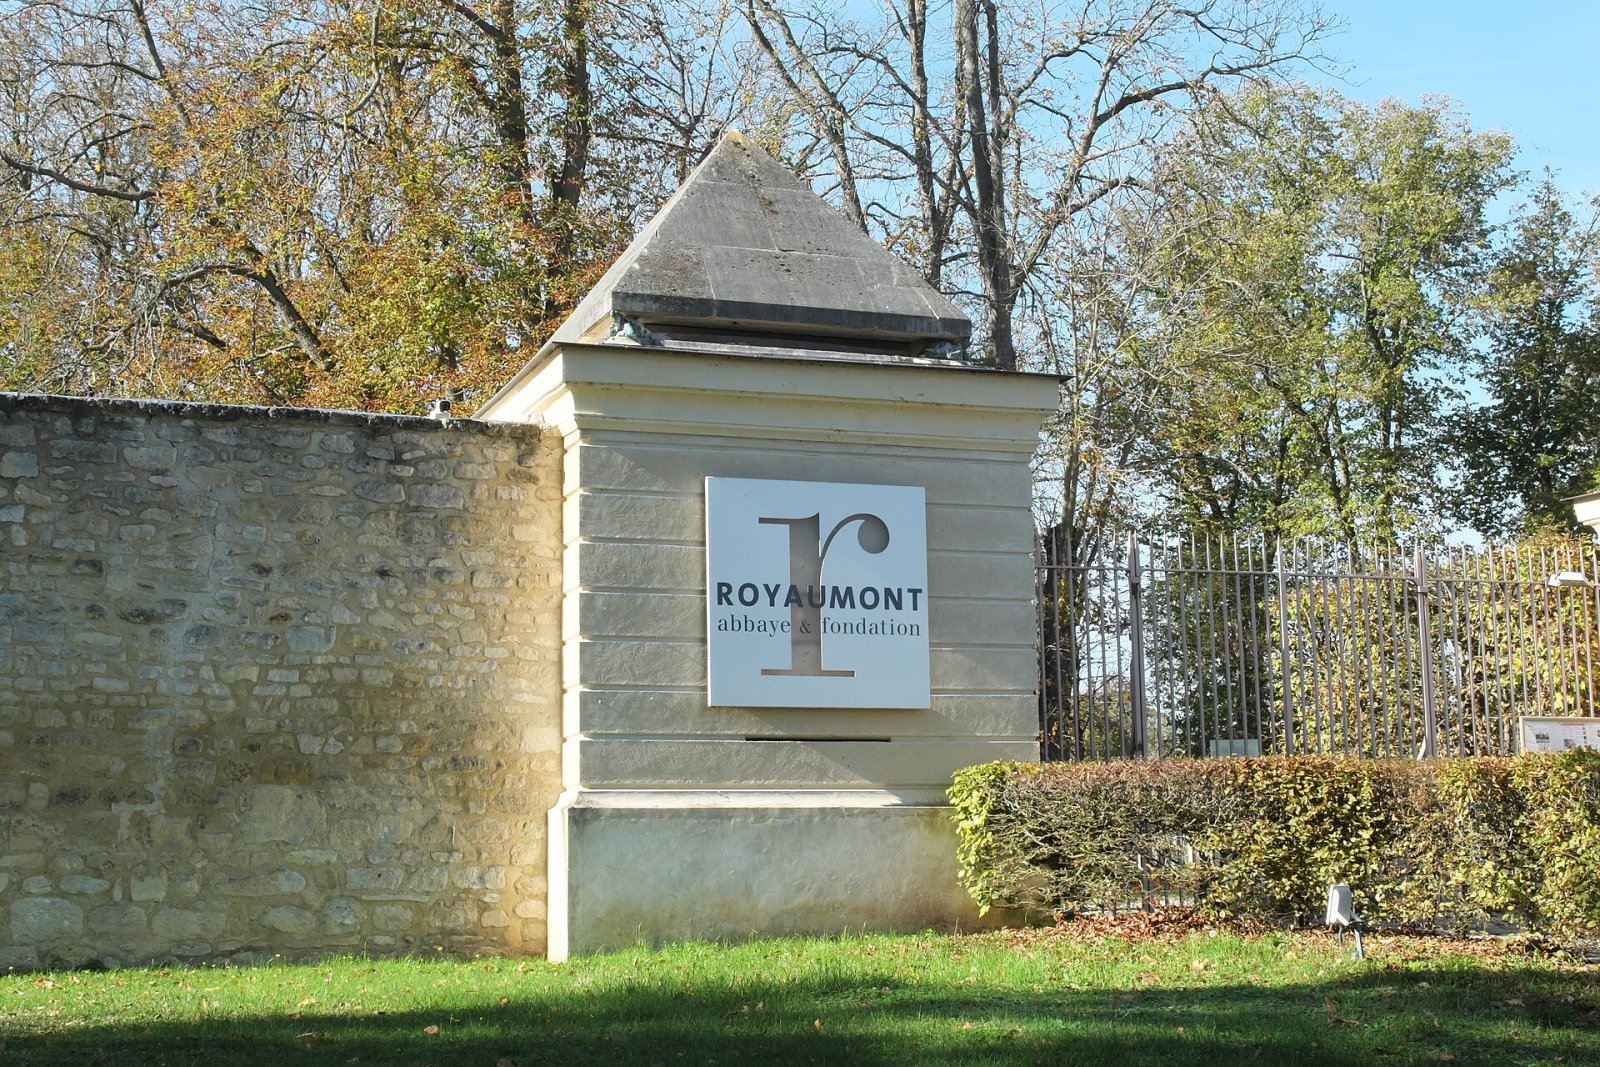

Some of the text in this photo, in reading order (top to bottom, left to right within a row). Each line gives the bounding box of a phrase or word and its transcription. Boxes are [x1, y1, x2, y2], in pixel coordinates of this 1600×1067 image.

[717, 582, 922, 611] ROYAUMONT
[718, 614, 920, 637] abbaye & fondation
